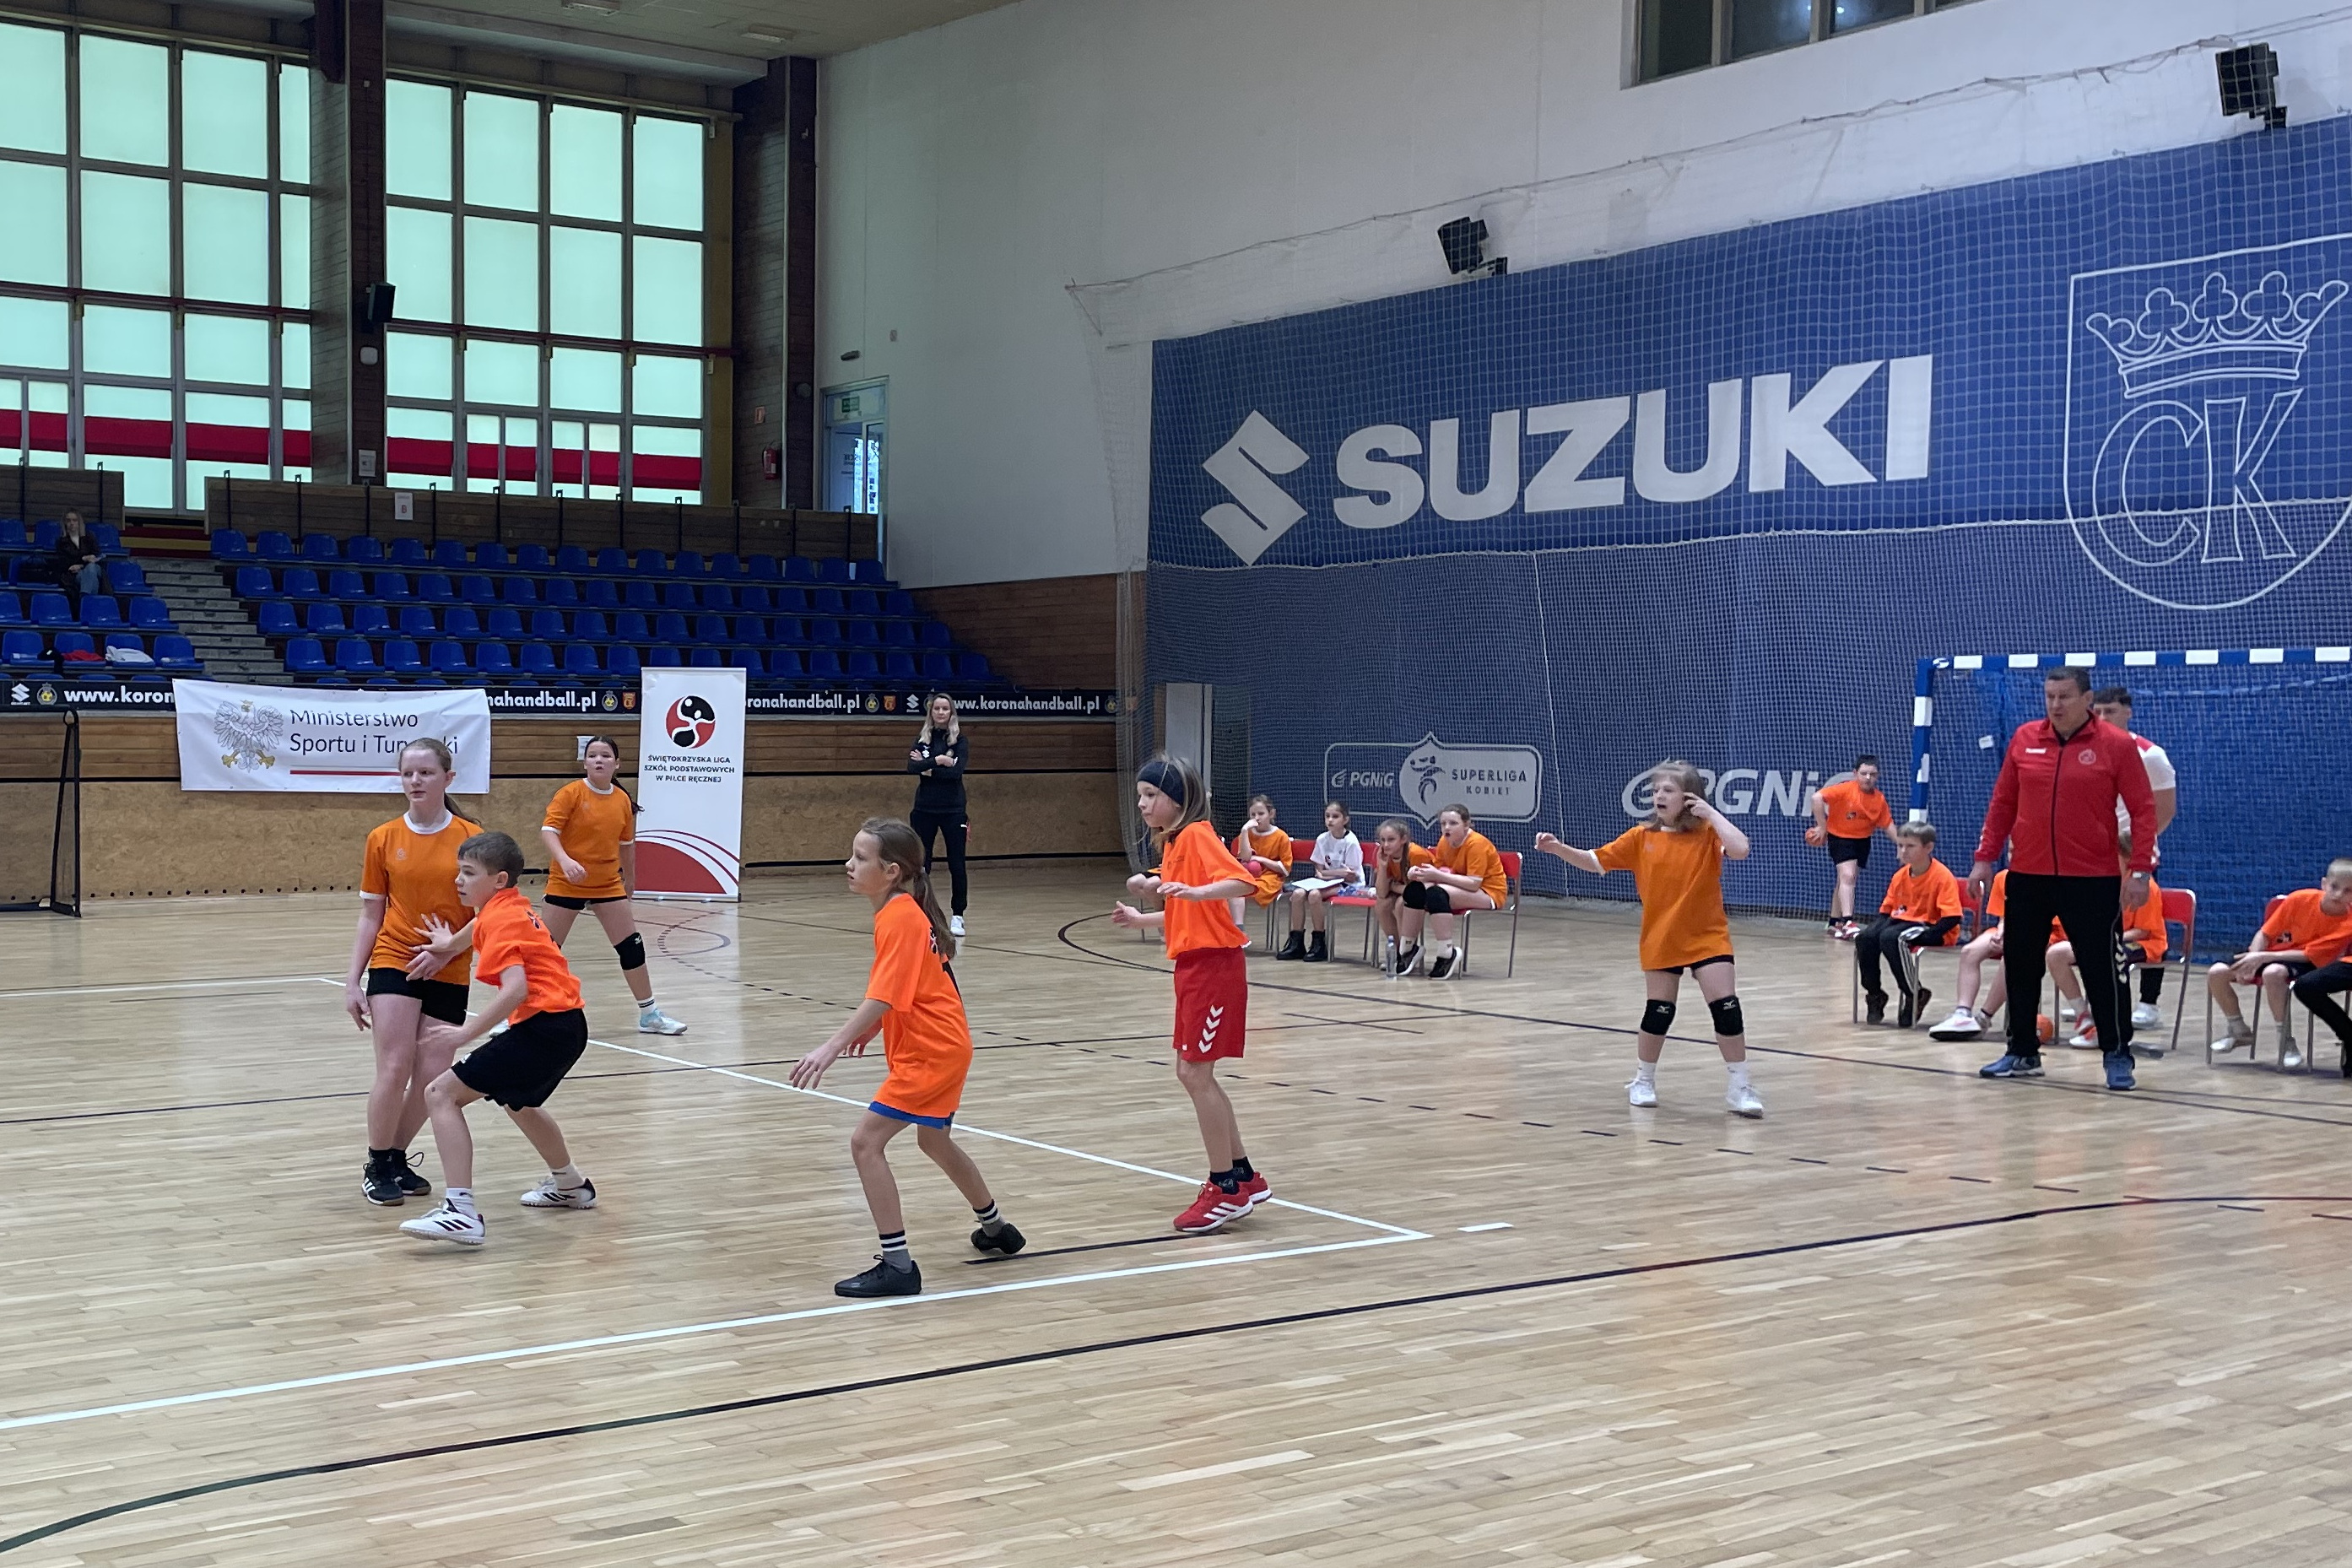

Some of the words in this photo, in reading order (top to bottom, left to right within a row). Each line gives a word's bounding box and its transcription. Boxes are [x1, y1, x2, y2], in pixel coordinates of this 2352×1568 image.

[1333, 354, 1933, 529] SUZUKI
[64, 685, 176, 703] www.koron
[487, 690, 597, 712] nahandball.pl
[745, 693, 860, 713] ronahandball.pl
[952, 695, 1100, 714] ww.koronahandball.pl
[289, 709, 419, 727] Ministerstwo
[289, 733, 356, 755] Sportu
[362, 734, 367, 753] i
[372, 734, 458, 754] Turki
[647, 754, 712, 764] ŚWIĘTOKRZYSKA
[669, 765, 735, 774] PODSTAWOWYCH
[1452, 769, 1527, 782] SUPERLIGA
[1350, 771, 1394, 787] PGNiG
[1466, 786, 1511, 796] KOBIET
